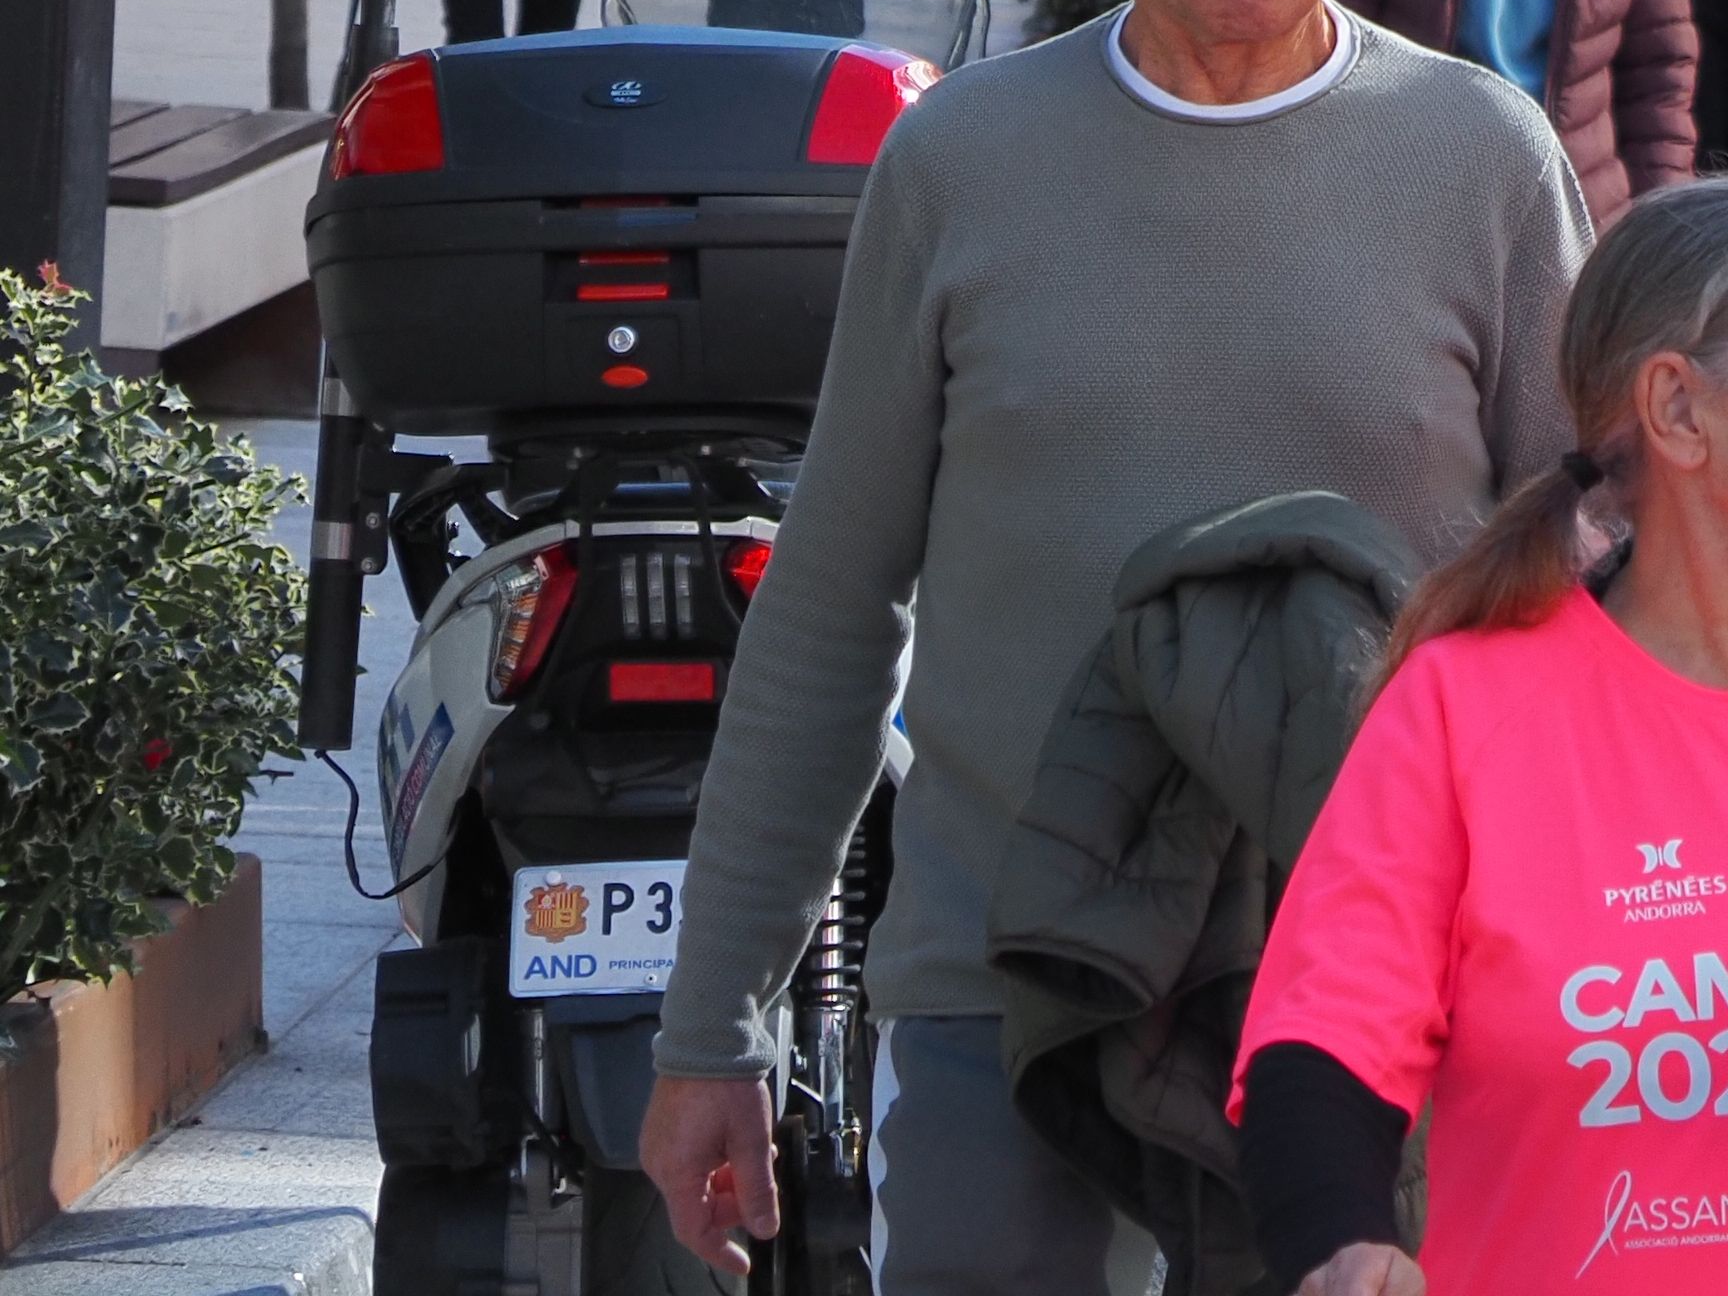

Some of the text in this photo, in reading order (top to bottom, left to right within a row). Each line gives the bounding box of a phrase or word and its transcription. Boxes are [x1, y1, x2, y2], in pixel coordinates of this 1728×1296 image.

[1604, 874, 1728, 908] PYRÉNÉES
[1623, 900, 1707, 923] ANDORRA
[524, 954, 598, 980] AND
